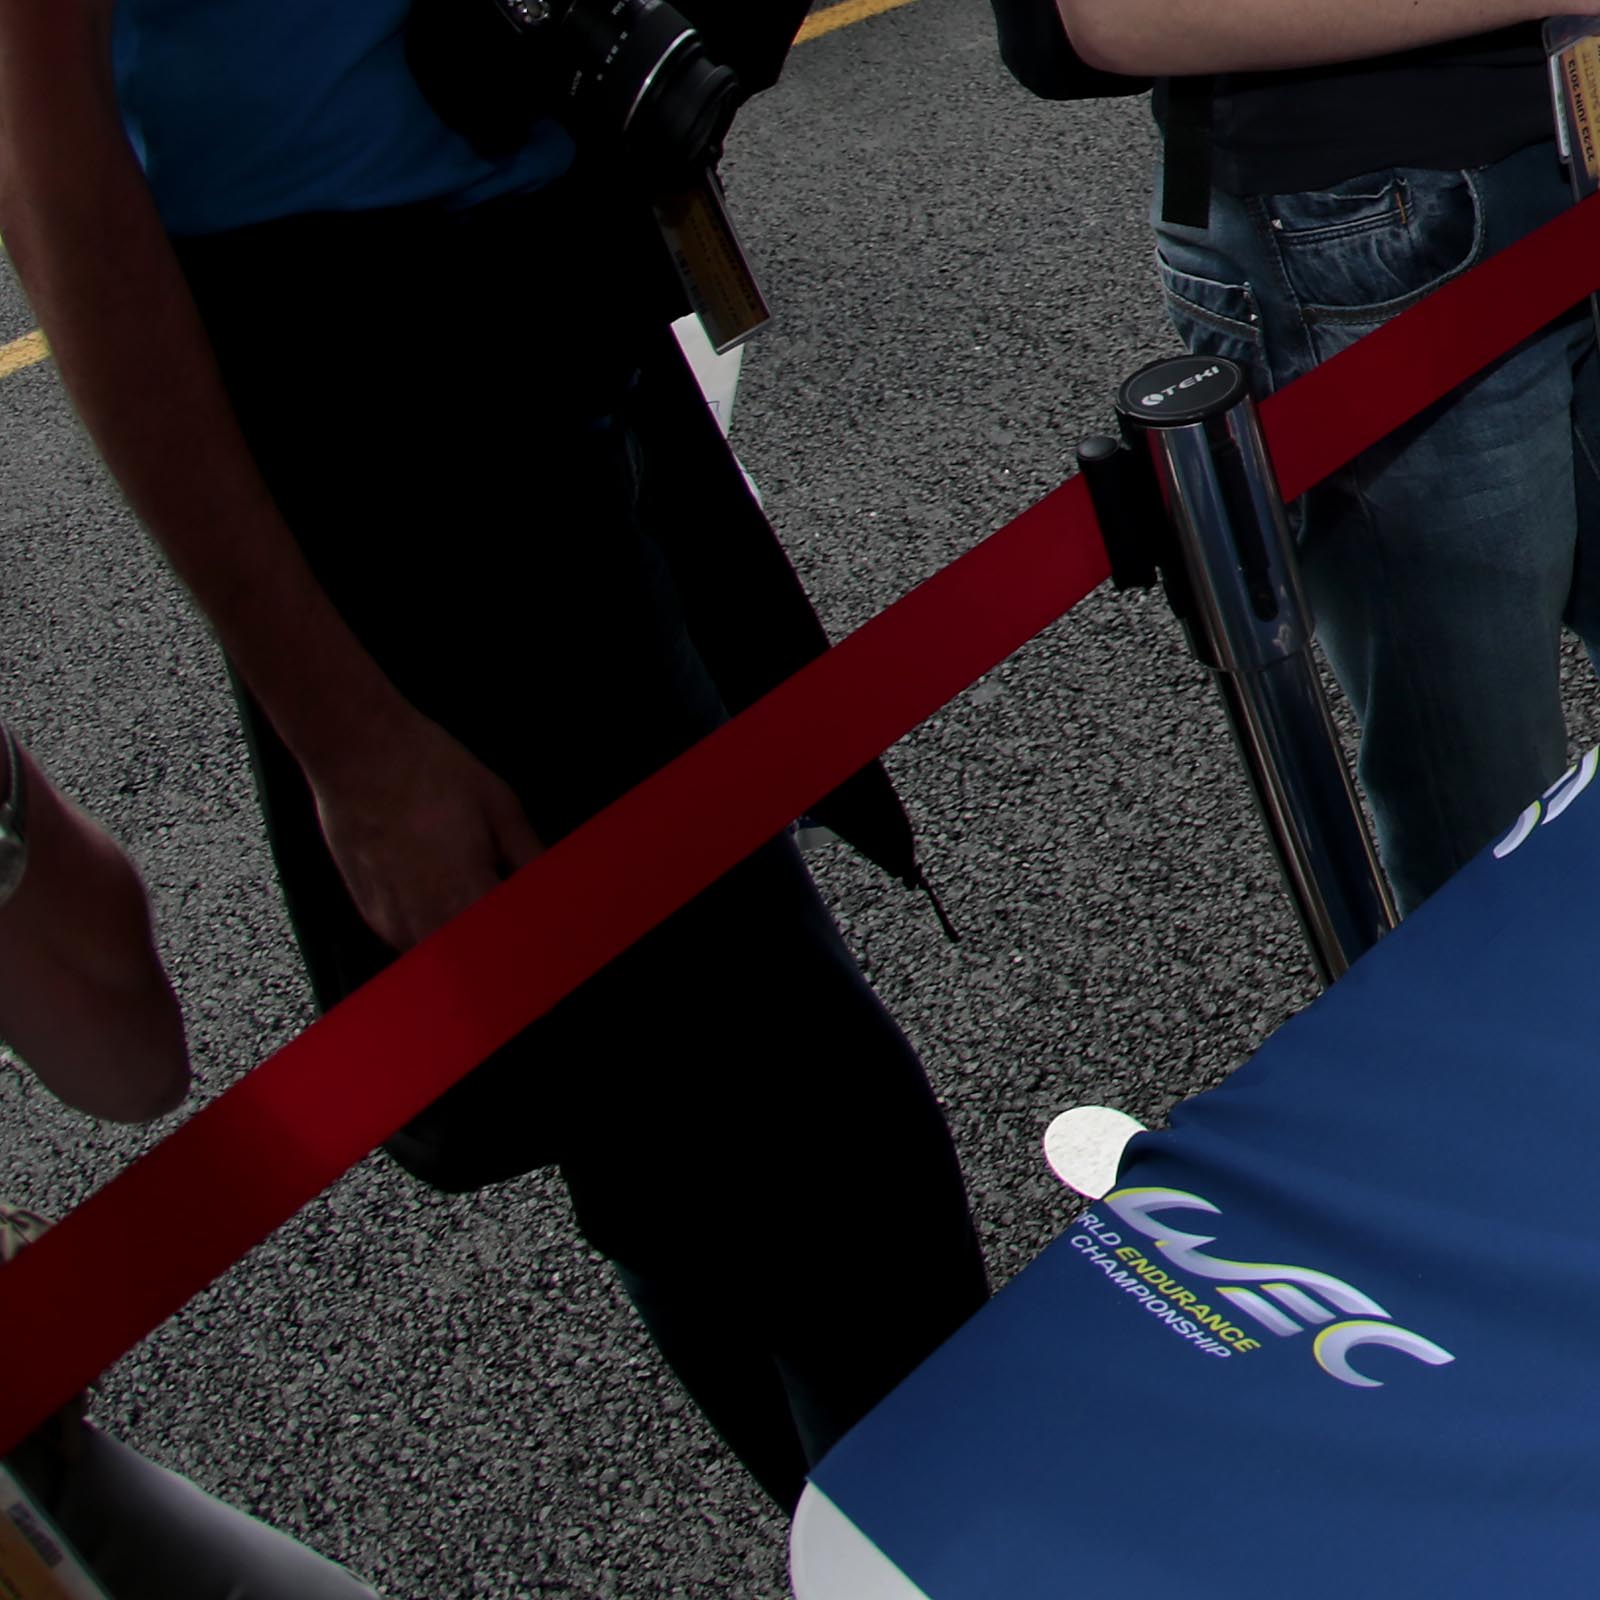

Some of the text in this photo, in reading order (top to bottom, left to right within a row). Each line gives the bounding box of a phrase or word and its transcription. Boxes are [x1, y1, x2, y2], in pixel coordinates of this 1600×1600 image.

[1070, 1234, 1232, 1360] CHAMPIONSHIP
[1079, 1210, 1262, 1354] RLD ENDURANCE
[1103, 1186, 1456, 1388] WEC
